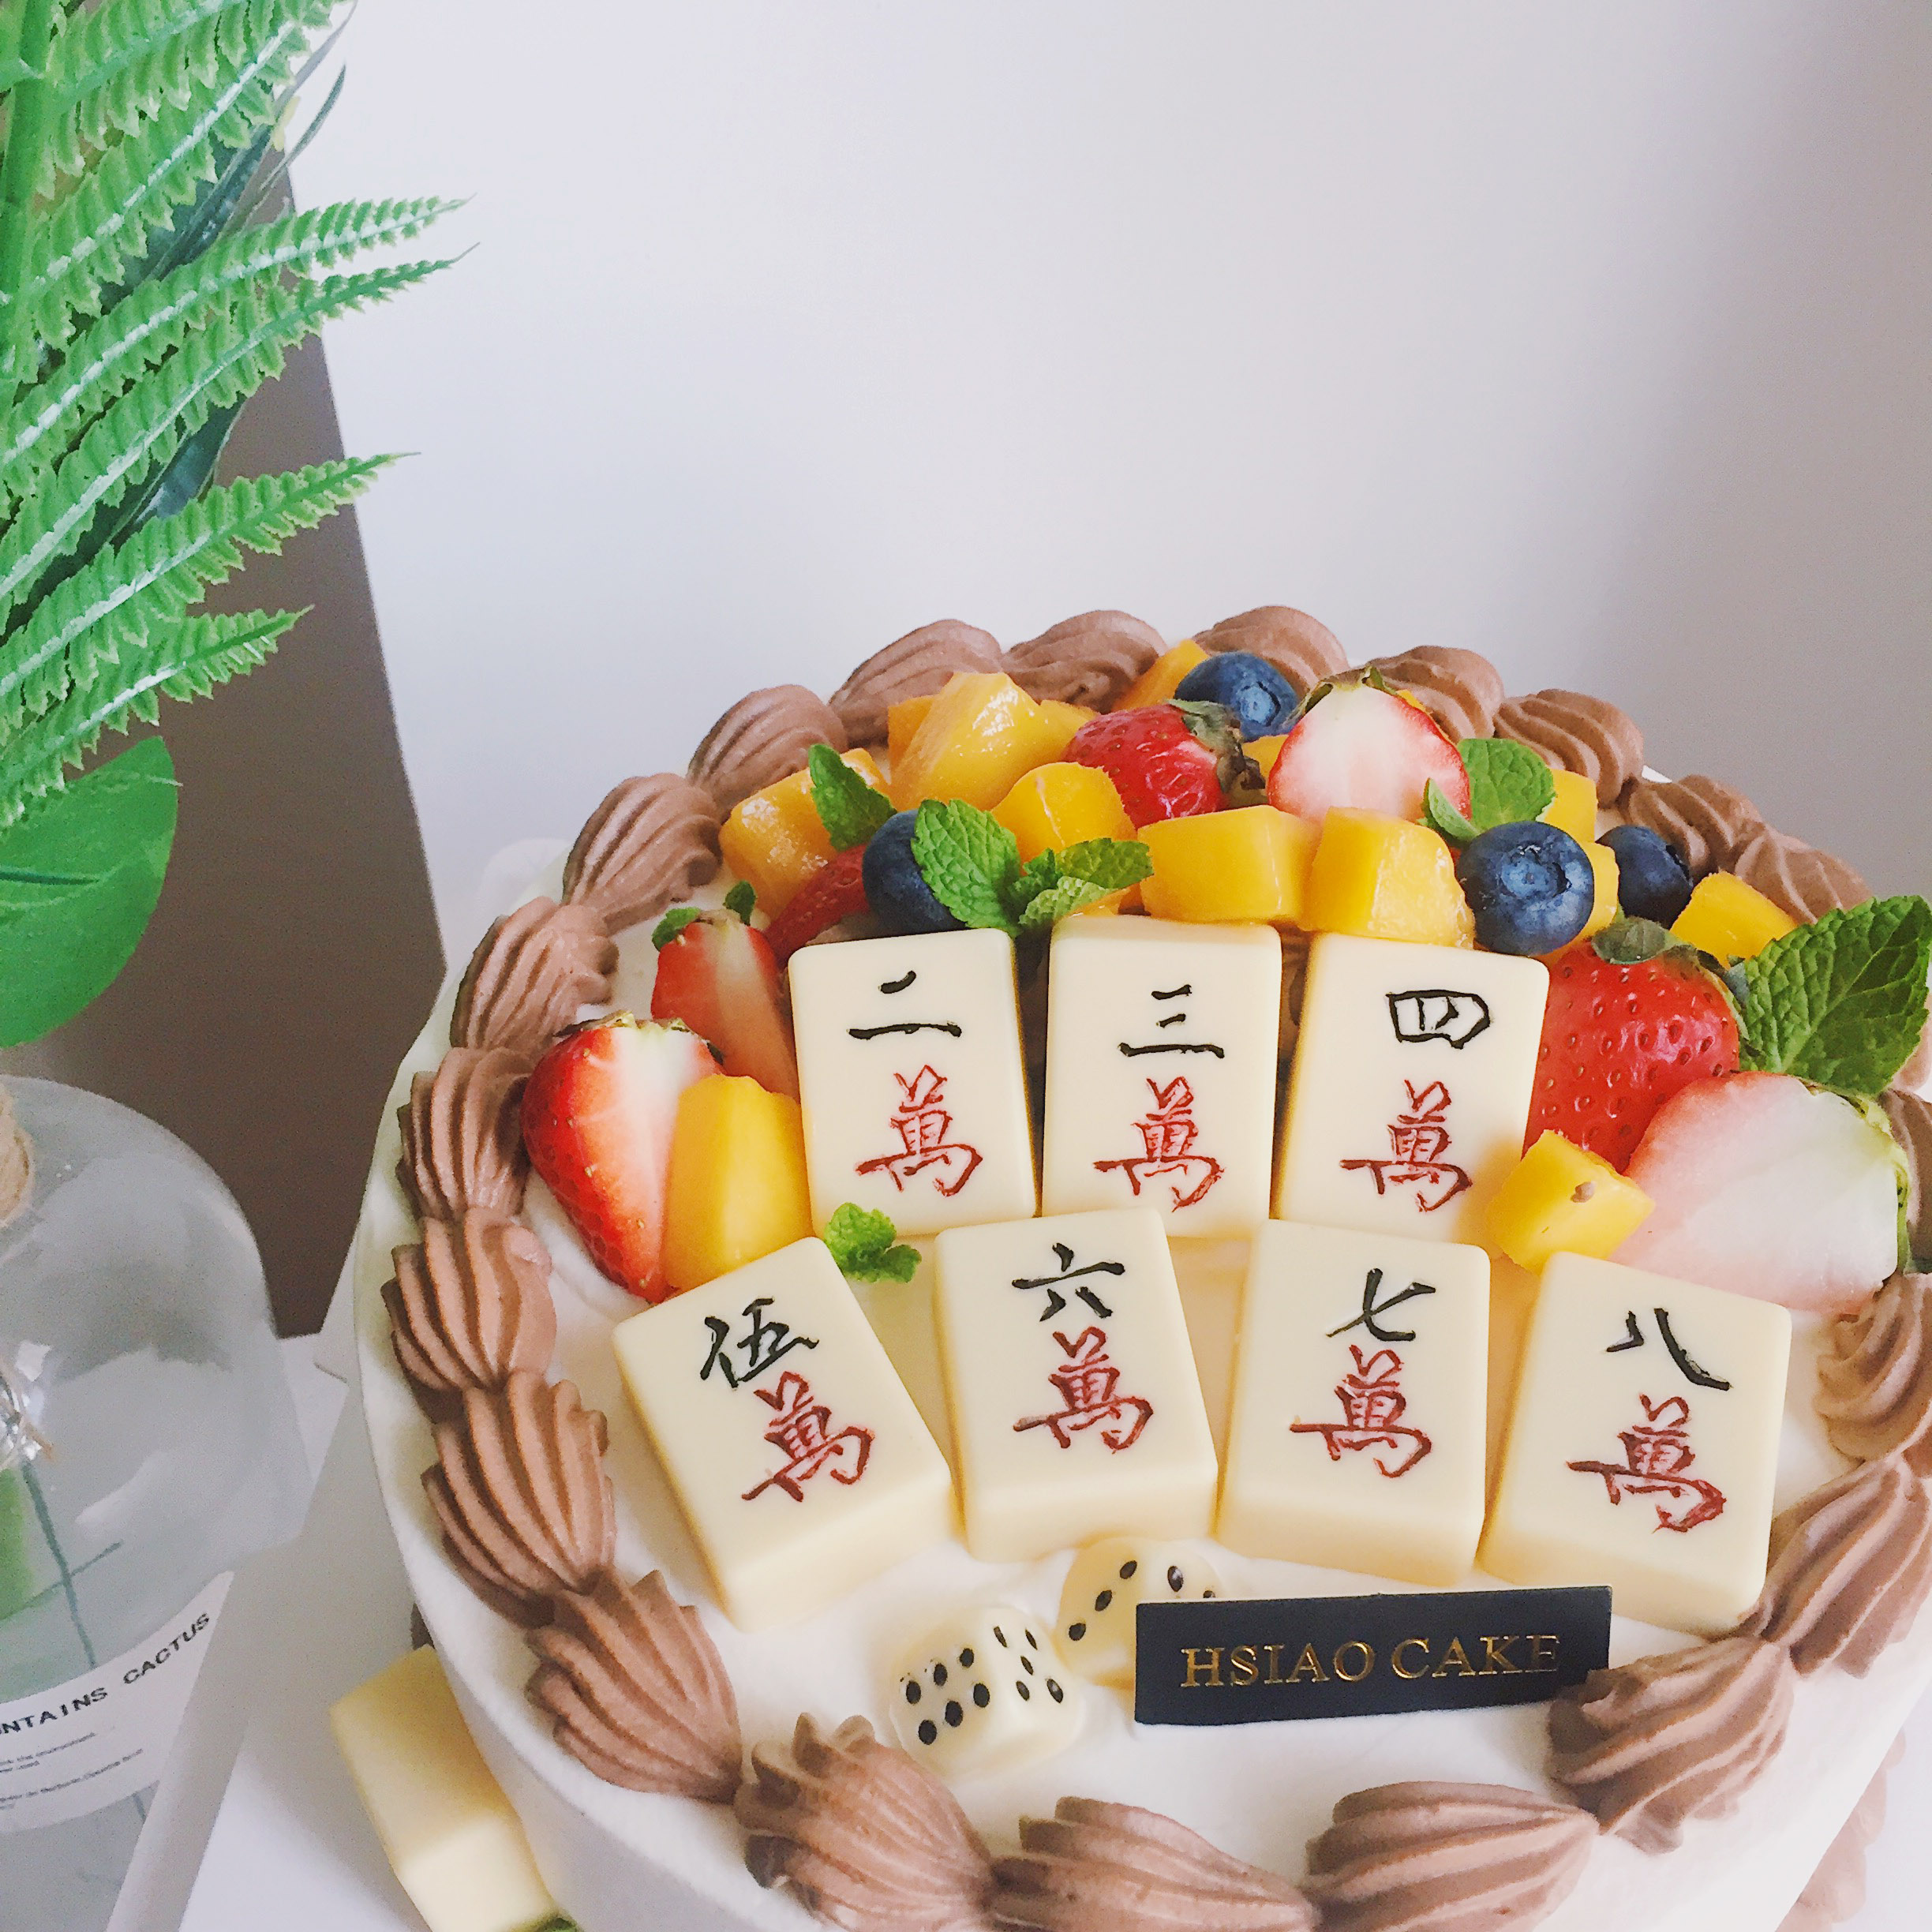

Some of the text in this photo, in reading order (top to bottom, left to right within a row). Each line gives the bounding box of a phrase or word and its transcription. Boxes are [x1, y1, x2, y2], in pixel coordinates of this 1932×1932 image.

[847, 970, 983, 1197] 二萬
[1093, 984, 1226, 1213] 三萬
[1339, 988, 1492, 1213] 四萬
[1012, 1242, 1154, 1454] 六萬
[1290, 1267, 1436, 1478] 七萬
[1567, 1307, 1732, 1533] 八萬
[0, 1612, 210, 1735] NTAINS CACTUS
[1180, 1634, 1561, 1689] HSIAO CAKE
